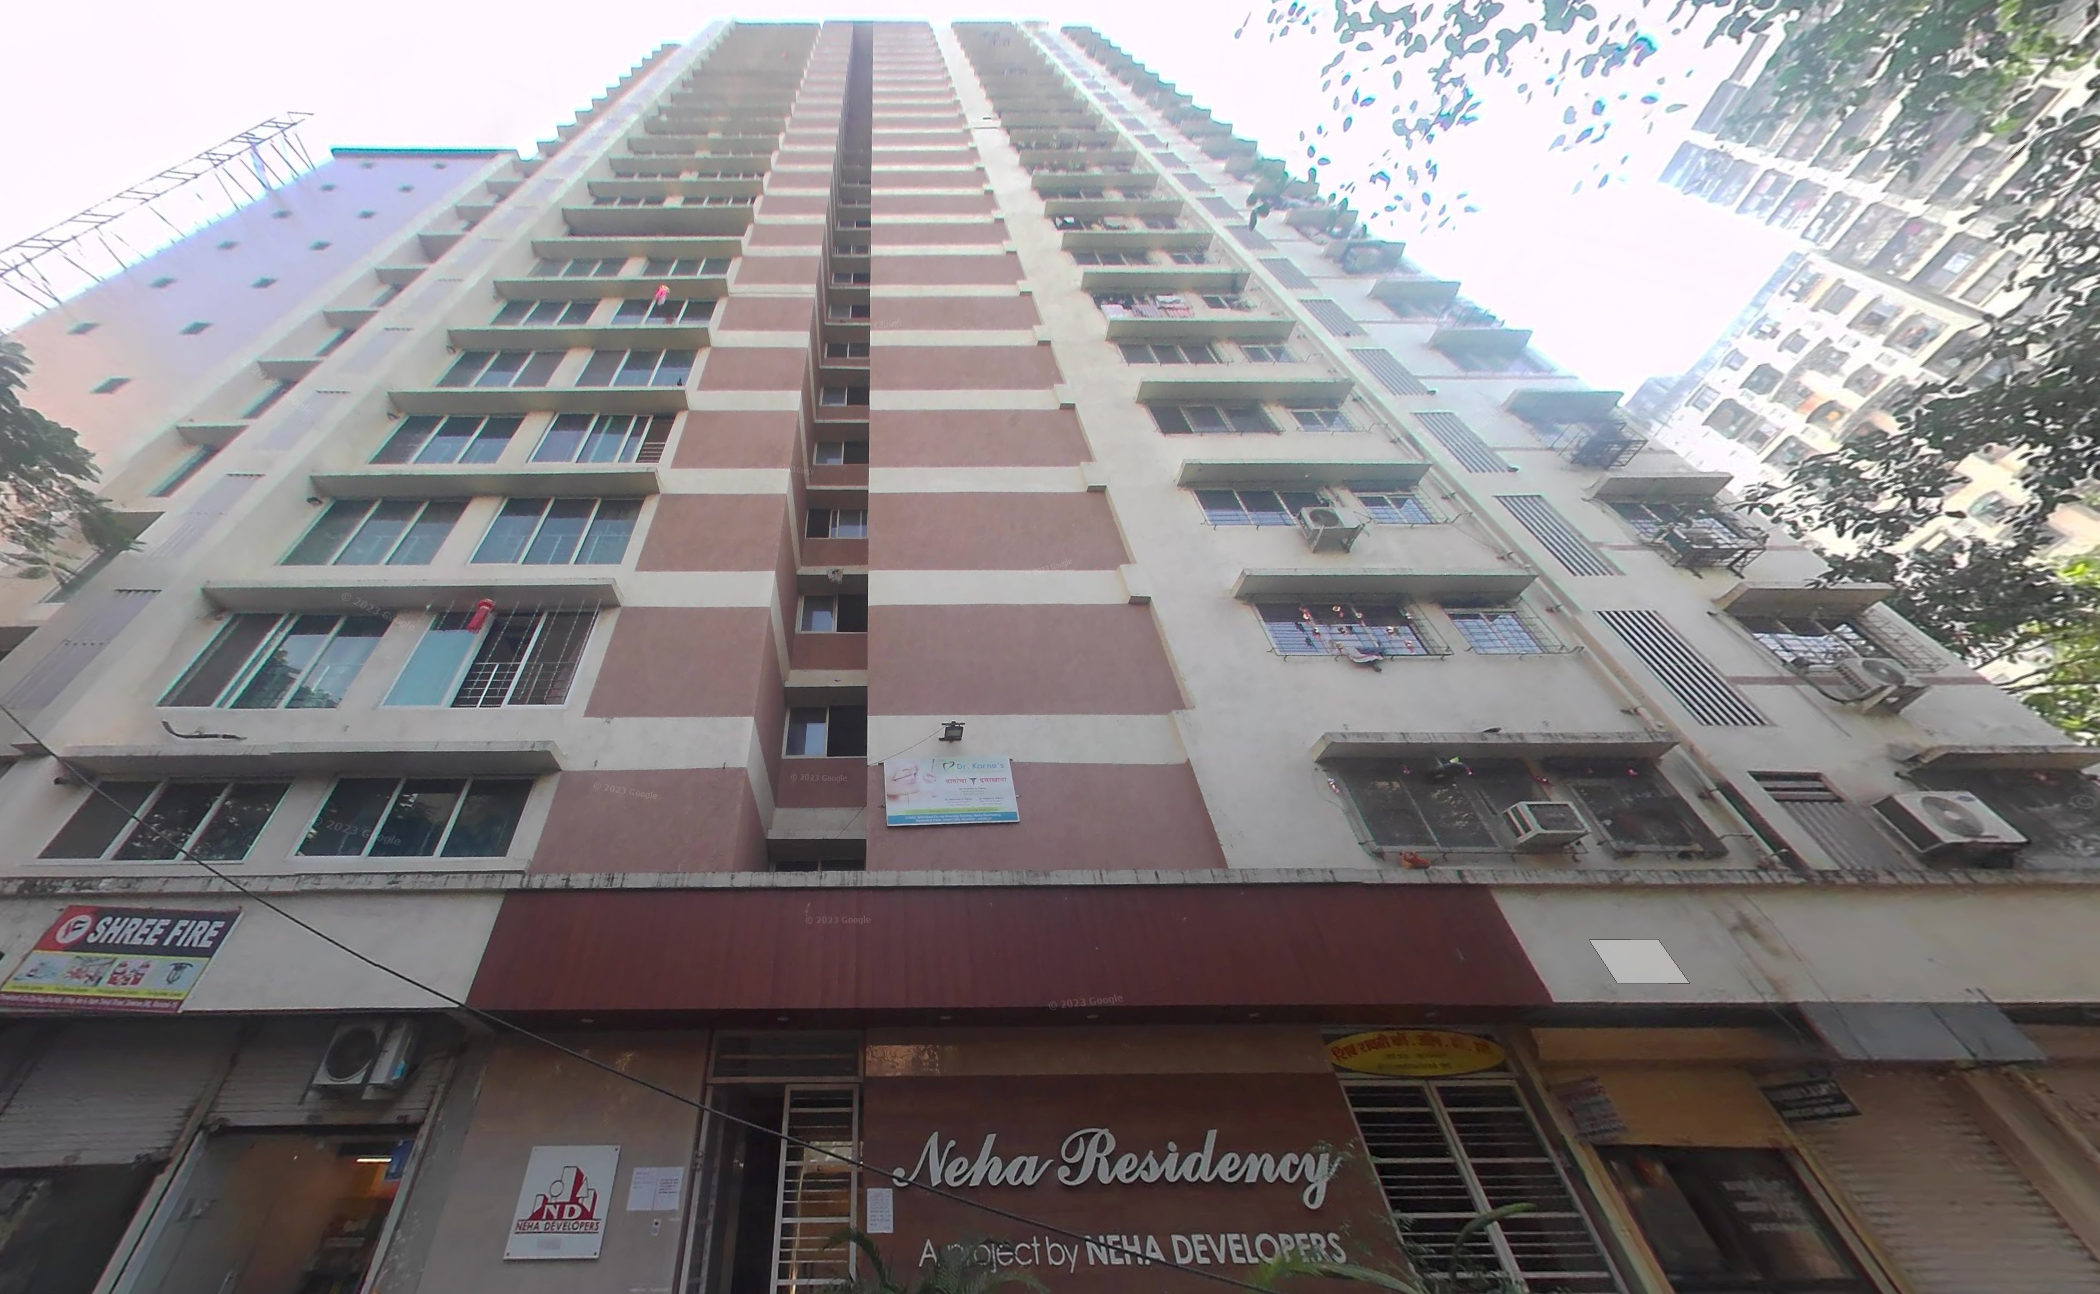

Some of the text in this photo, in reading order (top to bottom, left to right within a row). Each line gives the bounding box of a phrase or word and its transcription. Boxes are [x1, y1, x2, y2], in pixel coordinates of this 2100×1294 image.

[86, 916, 170, 946] SHREE
[162, 919, 225, 948] FIRE
[893, 1127, 1332, 1210] Neha Residency
[515, 1221, 600, 1231] NEHA DEVELOPERS
[542, 1203, 582, 1220] ND
[918, 1232, 1347, 1274] A oject by NEHA DEVELOPERS
